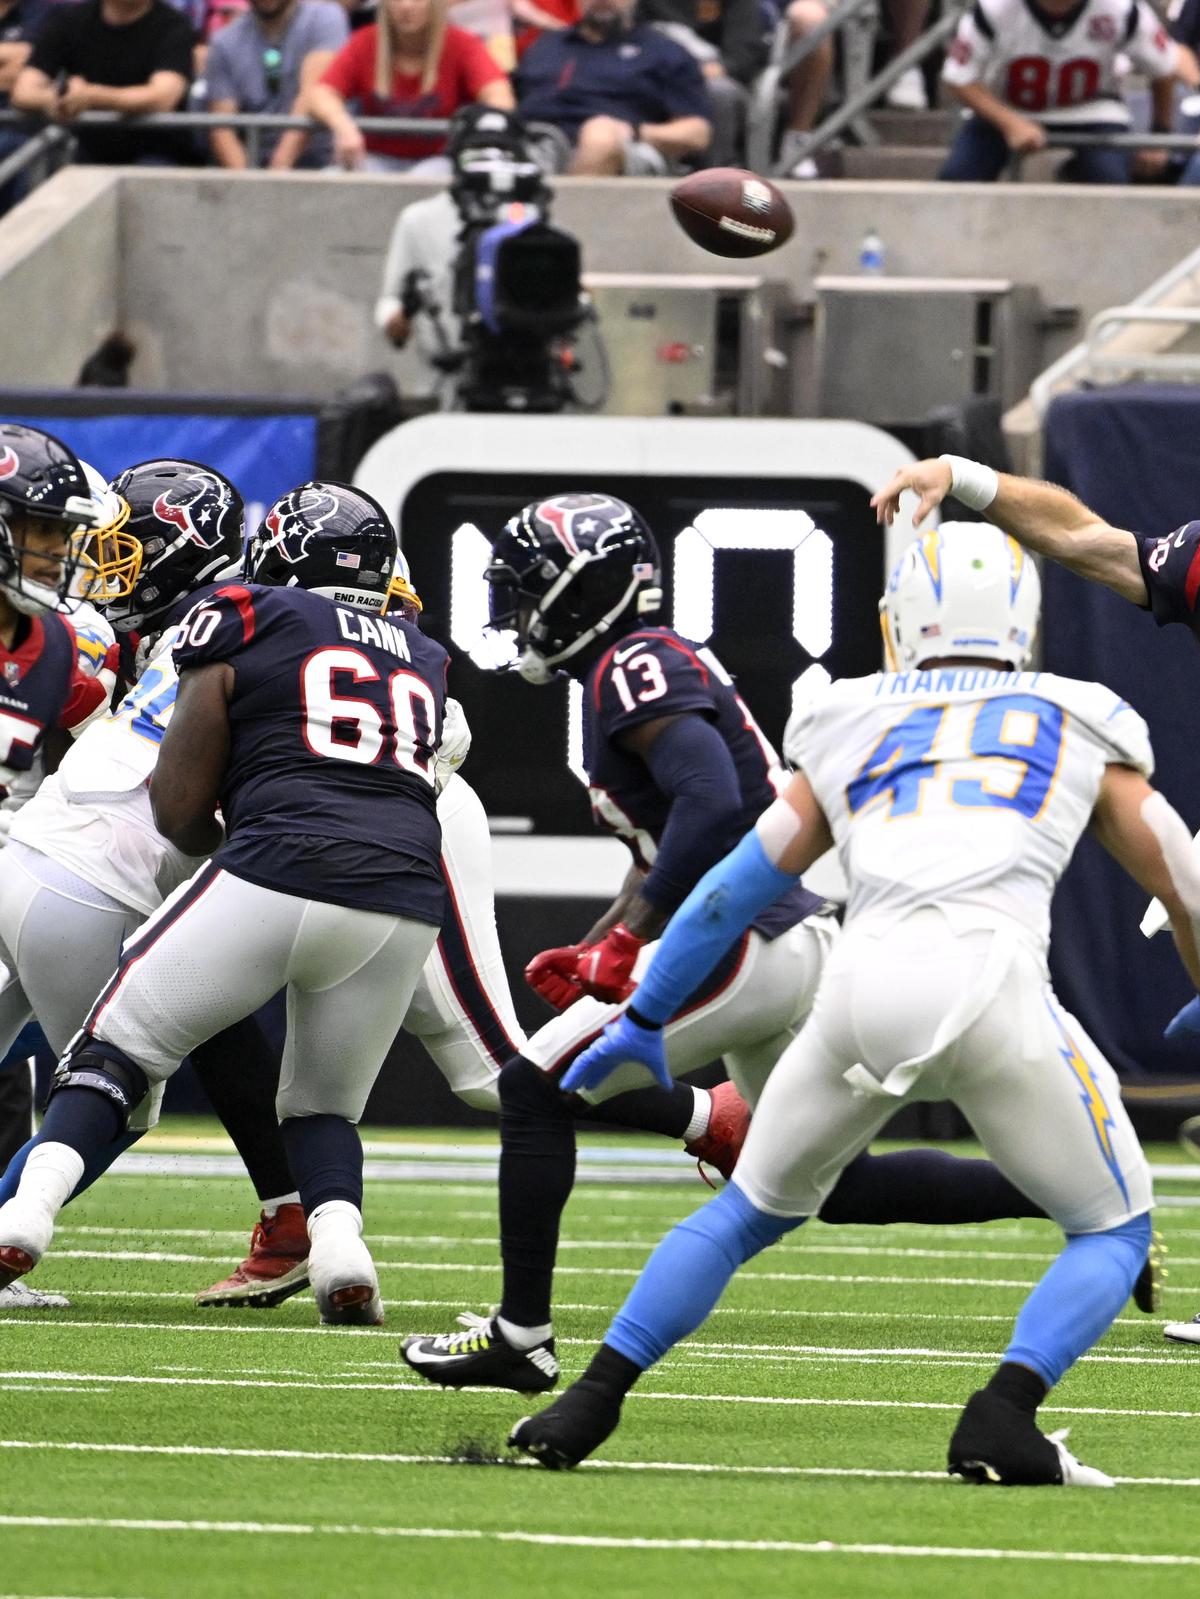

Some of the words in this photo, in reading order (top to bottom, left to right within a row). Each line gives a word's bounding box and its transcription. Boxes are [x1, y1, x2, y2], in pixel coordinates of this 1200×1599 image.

[1008, 56, 1100, 111] 80
[334, 592, 355, 603] END
[336, 608, 412, 663] CANN
[611, 653, 668, 712] 13
[299, 646, 438, 788] 60
[845, 693, 1069, 821] 49
